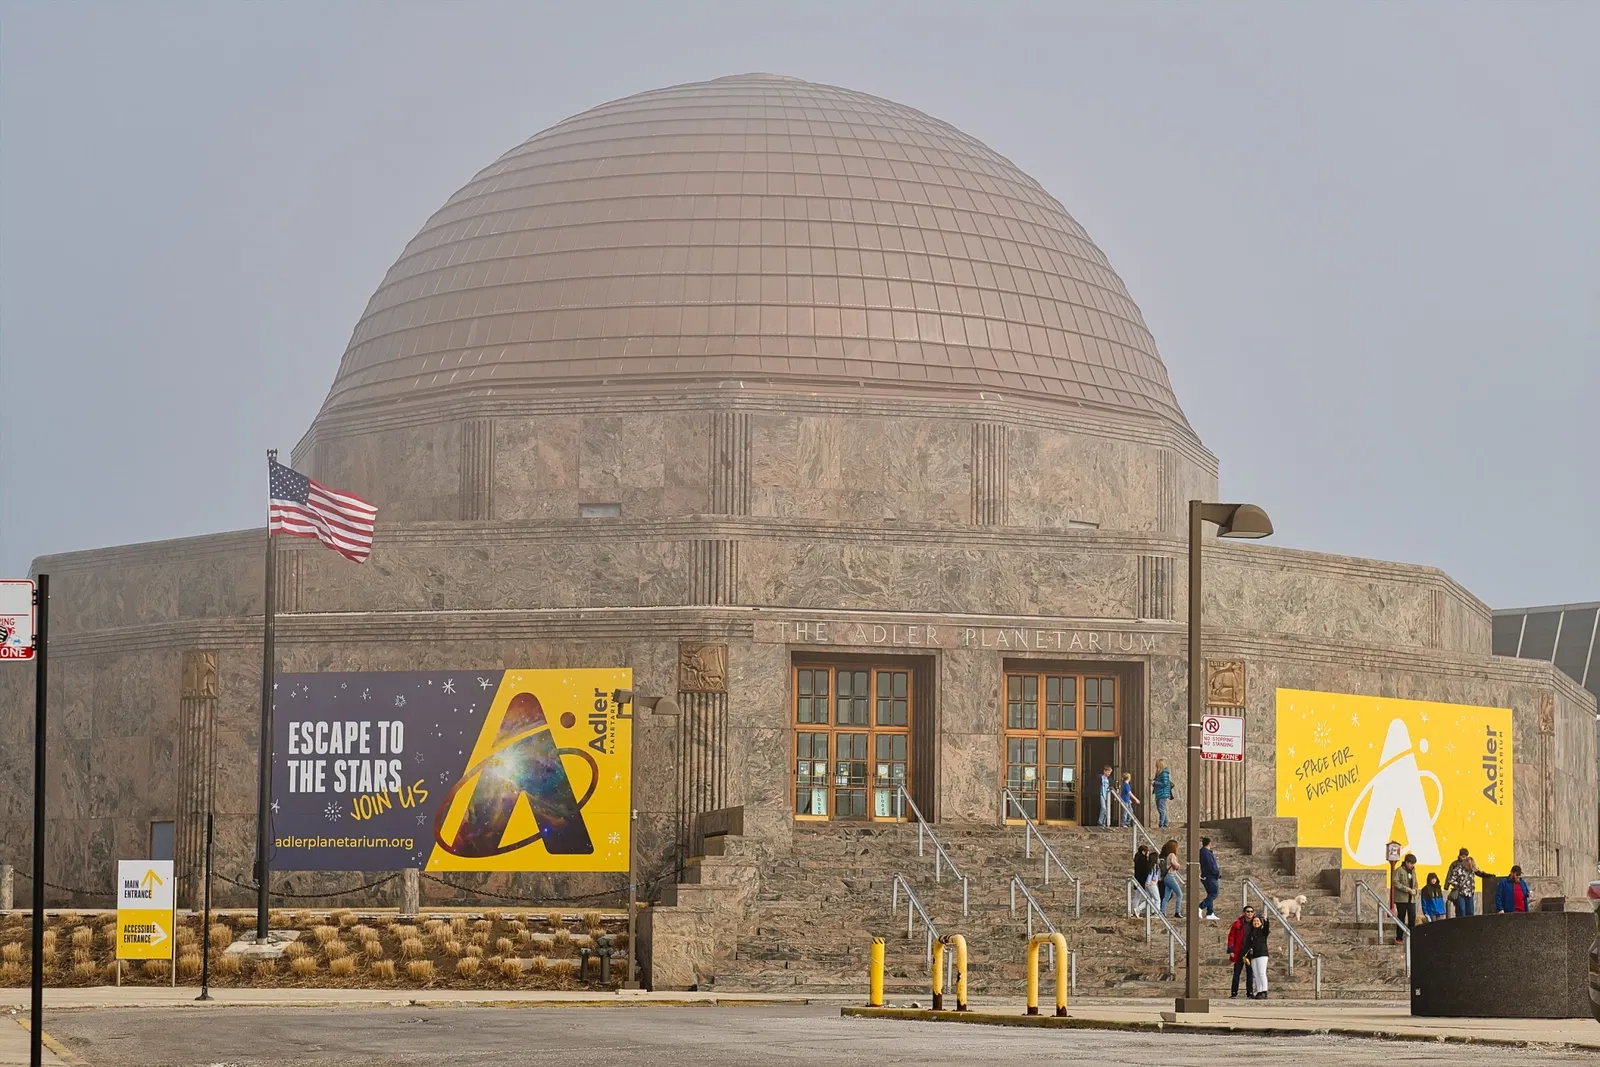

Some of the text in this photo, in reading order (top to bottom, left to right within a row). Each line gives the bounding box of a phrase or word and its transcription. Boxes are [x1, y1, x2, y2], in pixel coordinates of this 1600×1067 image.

[0, 647, 27, 658] ONE
[778, 621, 1157, 653] THE ADLER PLANETARIUM
[588, 688, 608, 754] Adler
[288, 721, 404, 755] ESCAPE TO
[287, 759, 402, 793] THE STARS
[1295, 746, 1354, 782] SPACE FOR
[1482, 724, 1498, 805] Adler
[350, 778, 429, 821] JOIN US
[1306, 764, 1361, 802] EVERYONE!
[275, 835, 414, 850] adlerplanetarium.org
[124, 880, 139, 889] MAIN
[124, 890, 152, 899] ENTRANCE
[123, 925, 156, 934] ACCESSIBLE
[123, 934, 151, 944] ENTRANCE
